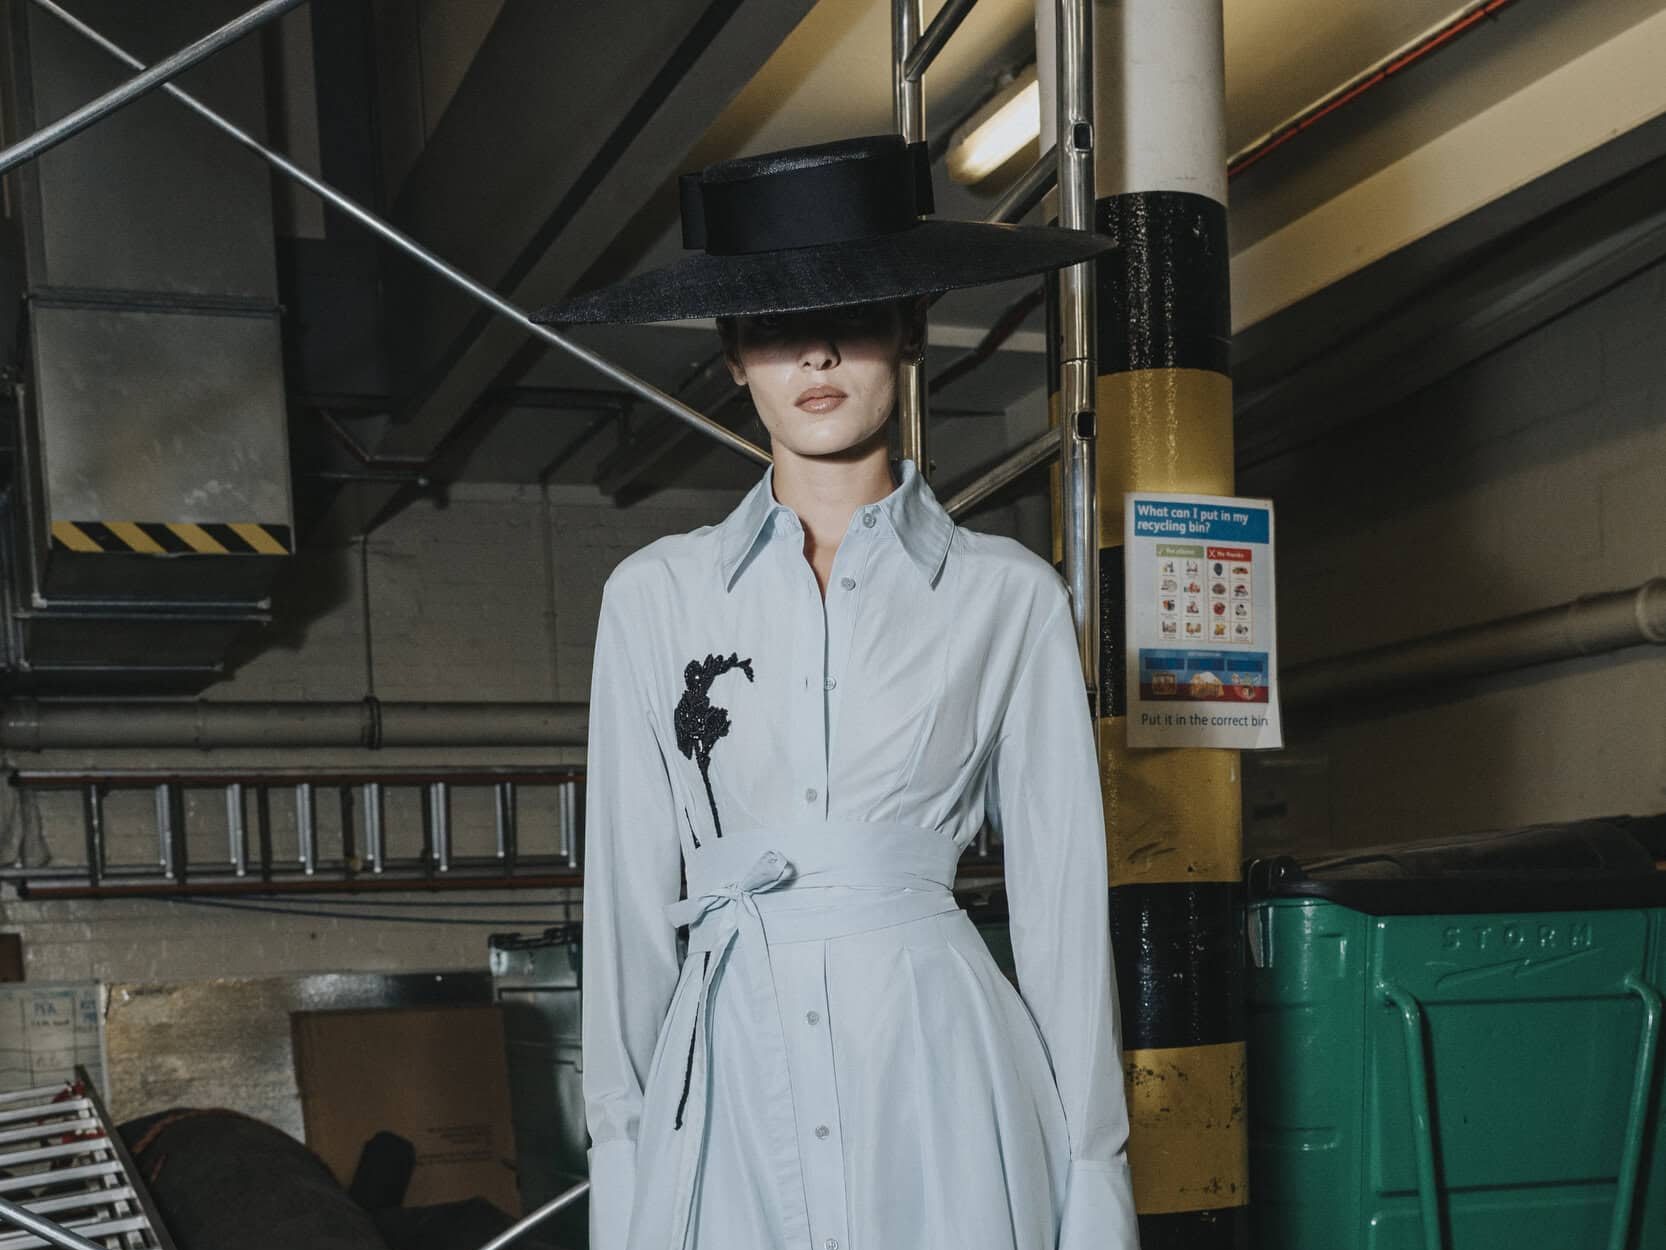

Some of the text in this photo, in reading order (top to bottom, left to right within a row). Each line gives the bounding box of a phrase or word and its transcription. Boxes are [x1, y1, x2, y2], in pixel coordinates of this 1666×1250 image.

[1137, 504, 1248, 525] What can I put in my
[1137, 520, 1211, 534] recycling bin?
[1141, 713, 1269, 727] Put it in the correct bin
[1441, 921, 1593, 950] STORM
